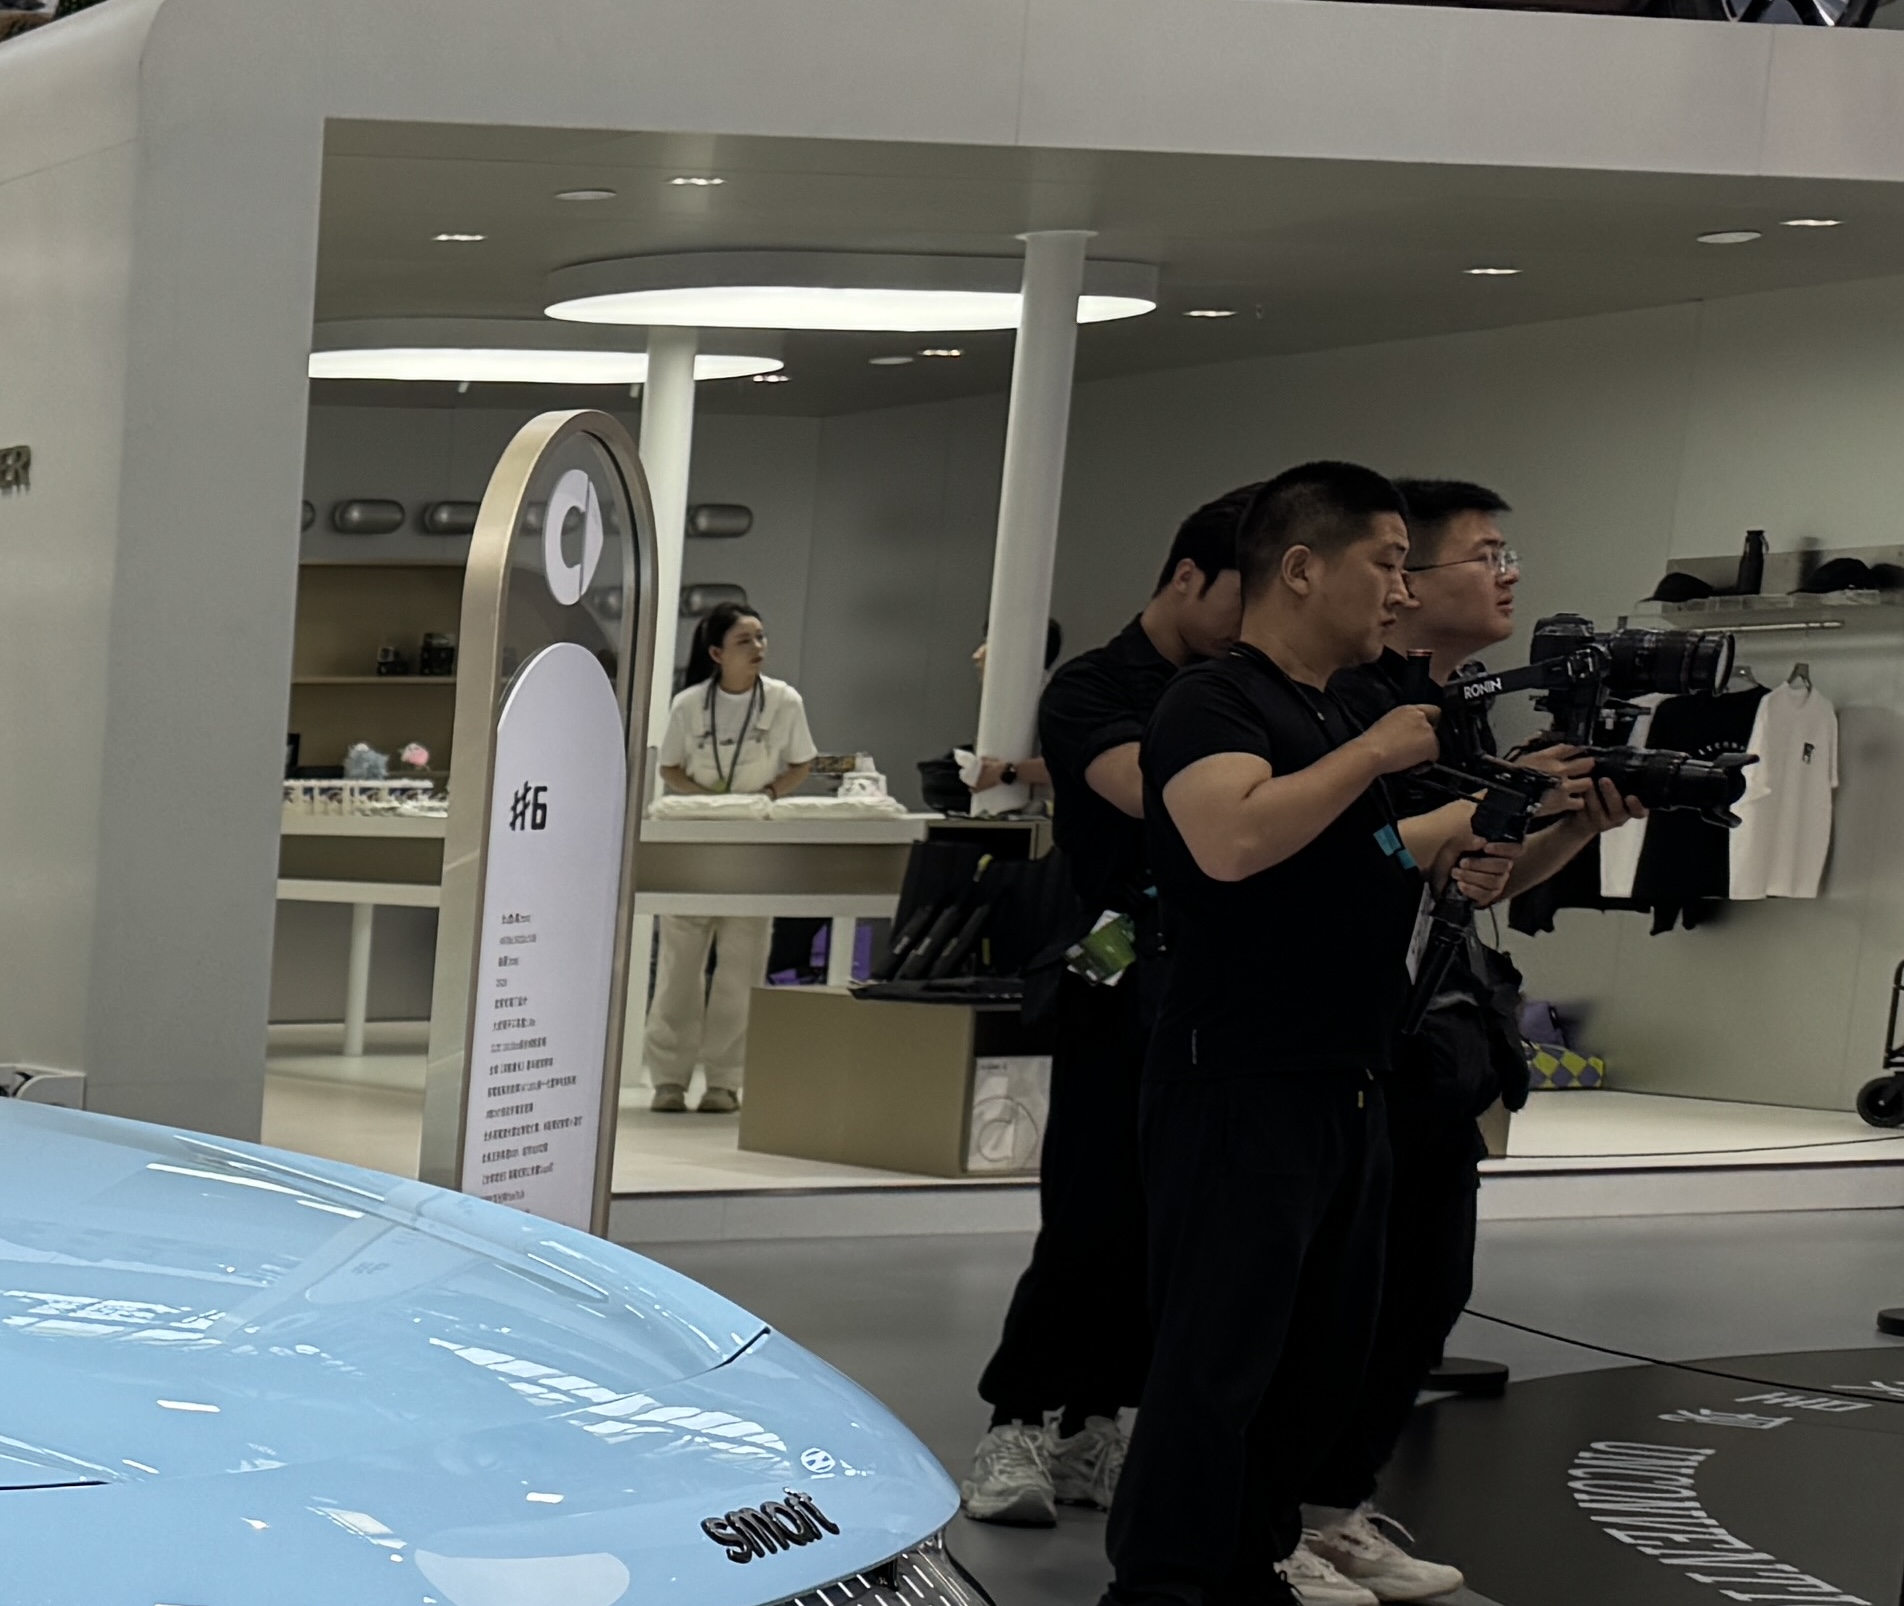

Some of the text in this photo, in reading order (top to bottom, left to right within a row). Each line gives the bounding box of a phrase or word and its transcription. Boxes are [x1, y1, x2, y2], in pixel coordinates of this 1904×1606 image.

[1463, 677, 1503, 700] RONIN
[509, 779, 549, 832] #6
[700, 1486, 841, 1564] smart
